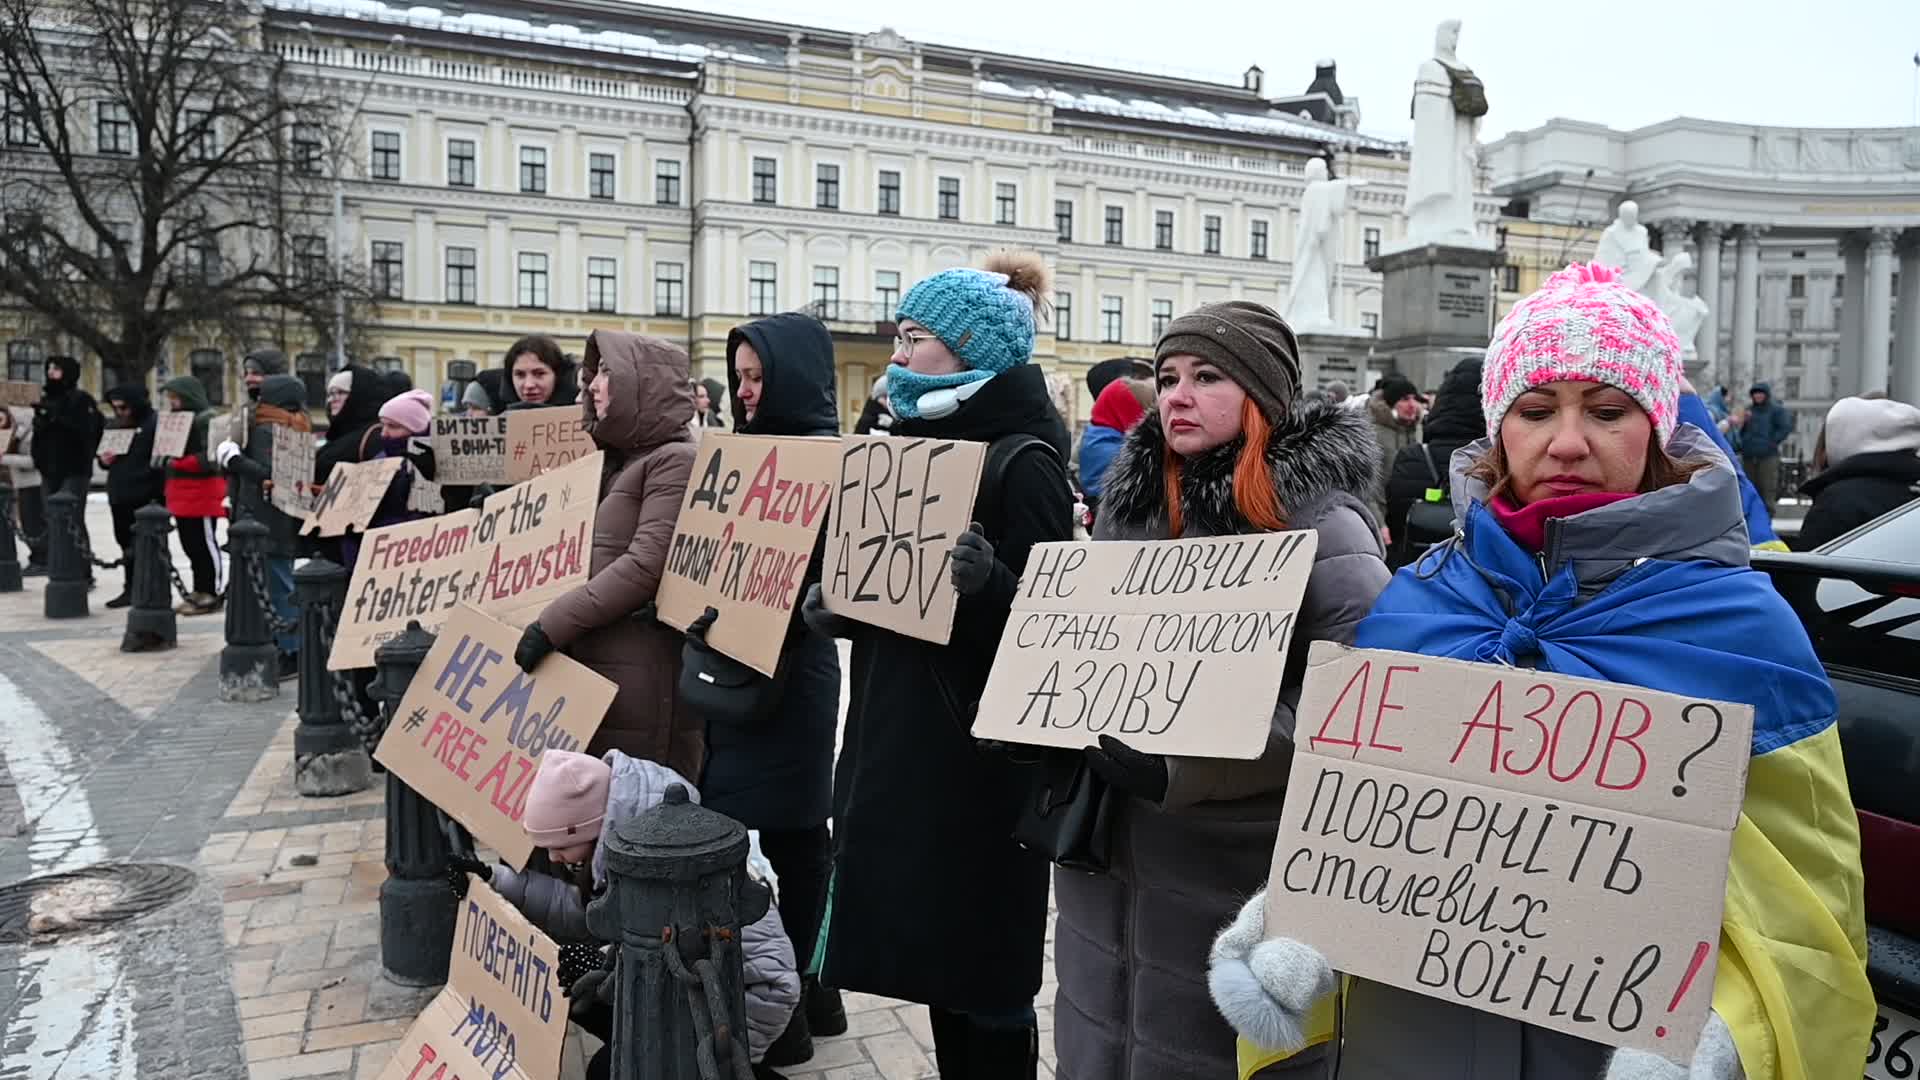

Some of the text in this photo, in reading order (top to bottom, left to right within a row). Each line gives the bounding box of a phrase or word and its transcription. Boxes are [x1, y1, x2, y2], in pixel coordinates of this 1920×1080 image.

[532, 420, 586, 446] FREE
[368, 522, 469, 570] Freedom
[509, 483, 548, 535] the
[689, 445, 830, 528] Де Azov
[835, 439, 955, 545] FREE
[354, 568, 464, 624] fighters
[832, 531, 952, 620] AZOV
[434, 634, 503, 714] НЕ
[1016, 611, 1293, 653] СТАНЬ ГОЛОСОМ
[1016, 659, 1203, 735] АЗОВУ
[1309, 660, 1420, 759] ДЕ
[421, 711, 488, 782] FREE
[474, 750, 538, 822] AZO
[1283, 847, 1548, 939] сталевих
[463, 901, 552, 1024] ПОВЕРНІТЬ
[451, 996, 516, 1080] МОГО
